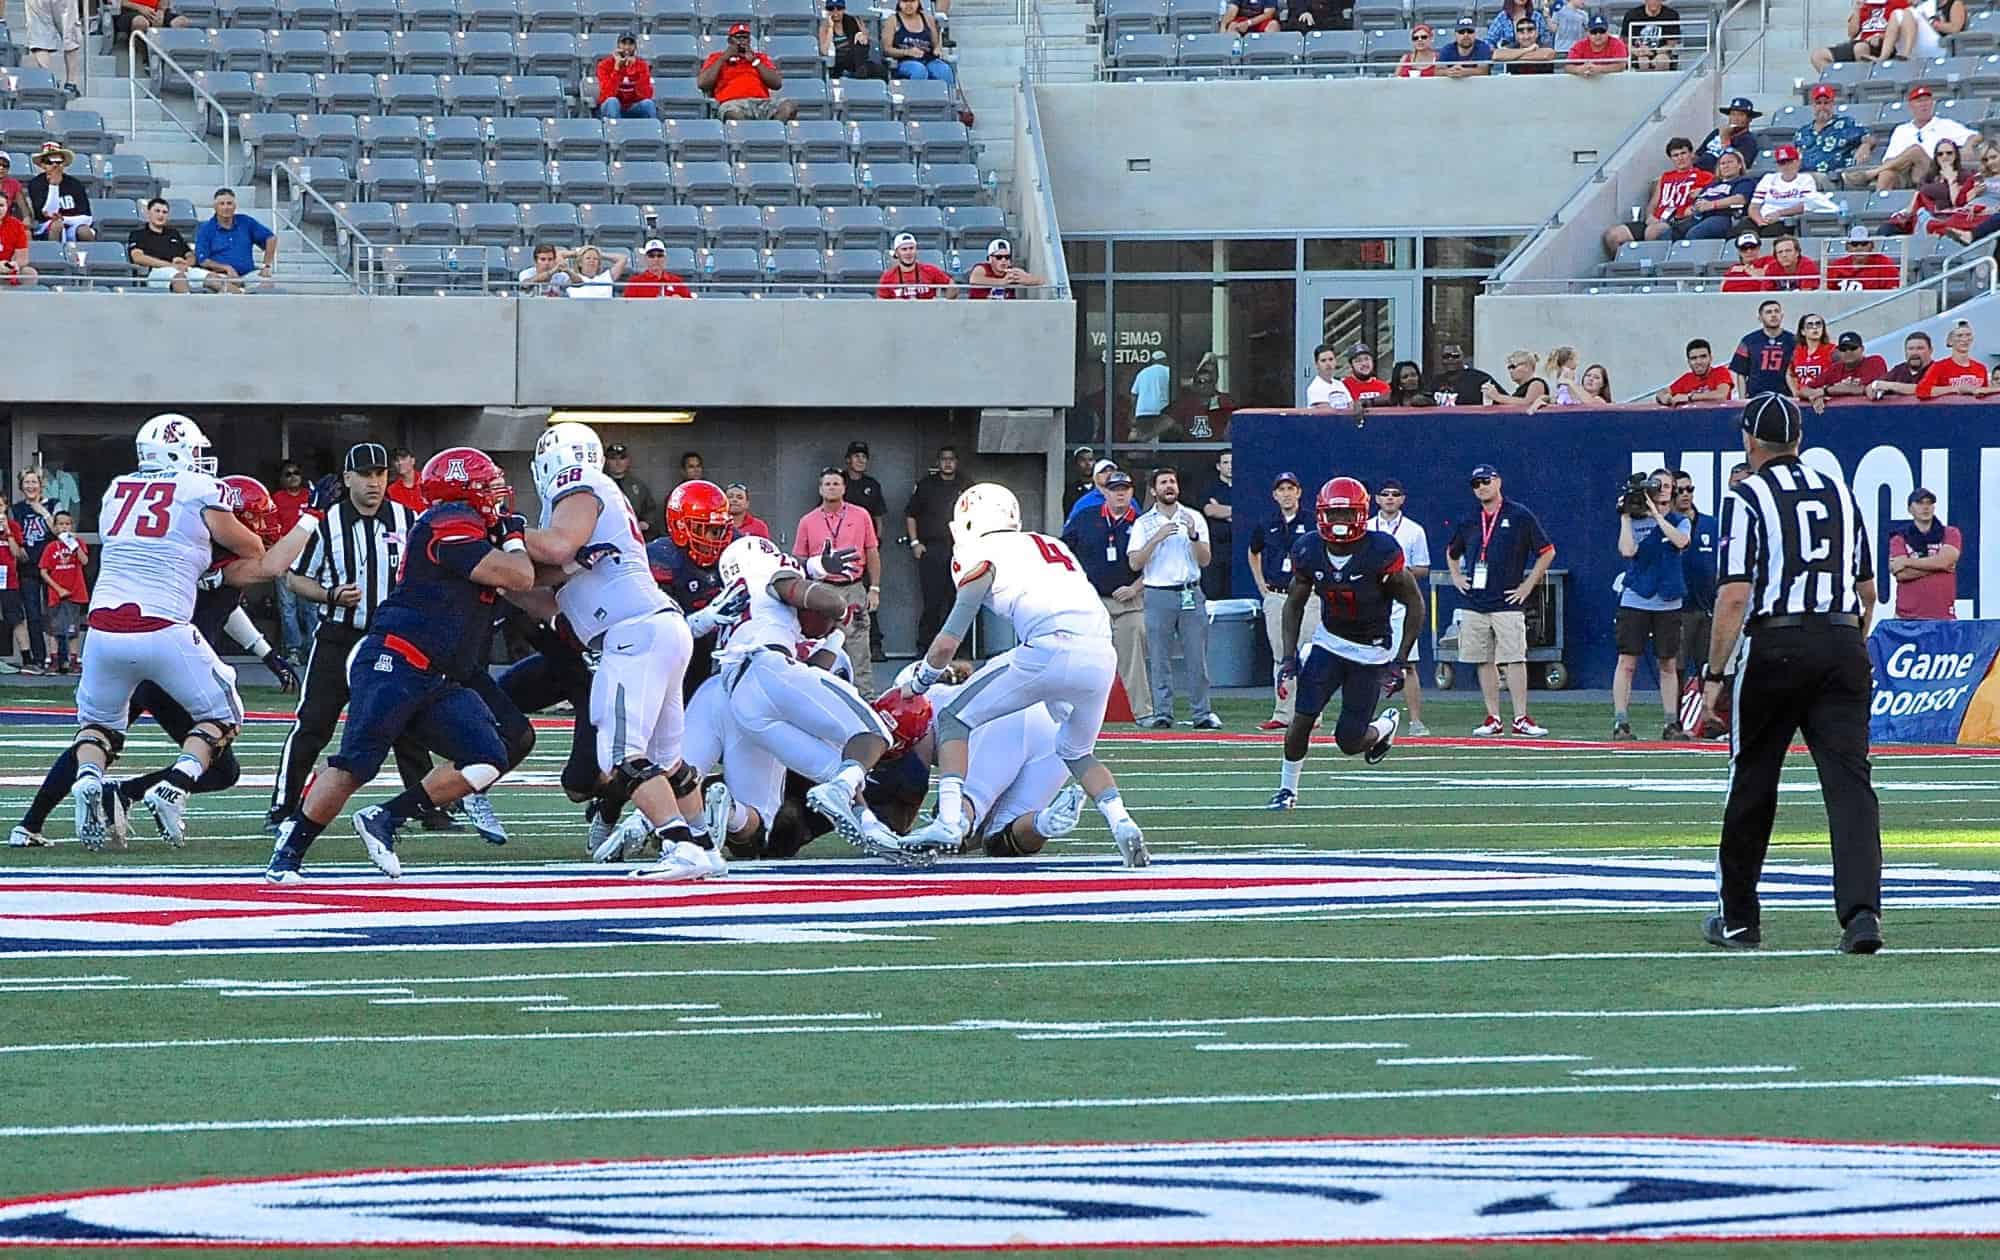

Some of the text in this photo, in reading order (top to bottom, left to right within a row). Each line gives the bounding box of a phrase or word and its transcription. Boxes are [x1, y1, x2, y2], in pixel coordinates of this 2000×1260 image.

[1760, 350, 1783, 371] 15
[556, 467, 583, 488] 58
[106, 482, 177, 538] 73
[1795, 500, 1830, 563] C
[1028, 533, 1077, 572] 4
[1886, 643, 1975, 680] Game
[1871, 679, 1970, 716] ponsor
